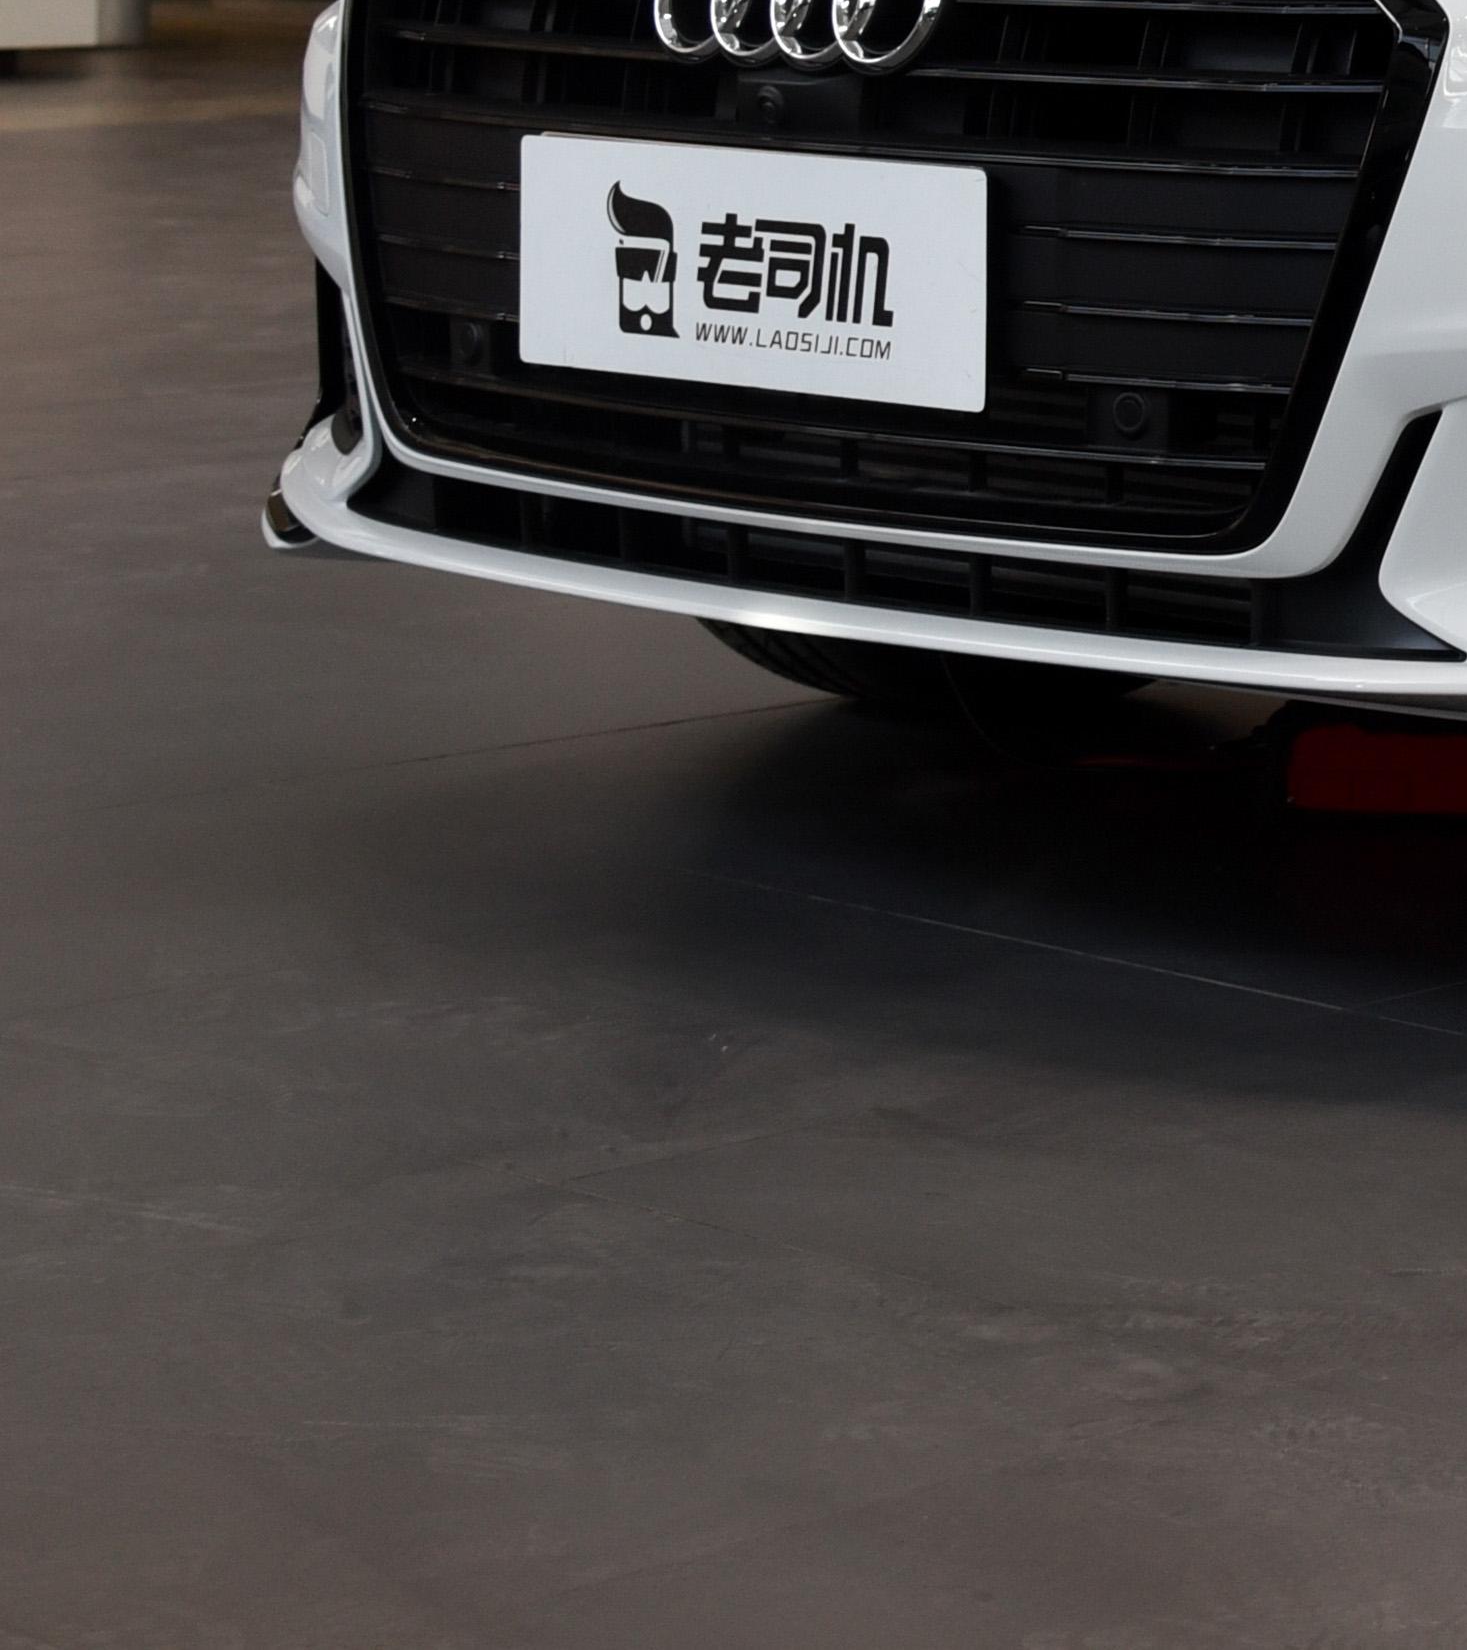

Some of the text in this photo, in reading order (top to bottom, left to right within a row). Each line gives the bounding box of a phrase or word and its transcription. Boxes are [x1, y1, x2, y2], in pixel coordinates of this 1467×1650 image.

[697, 213, 895, 327] 老司机
[695, 322, 892, 361] WWW.LAOSIJI.COM
